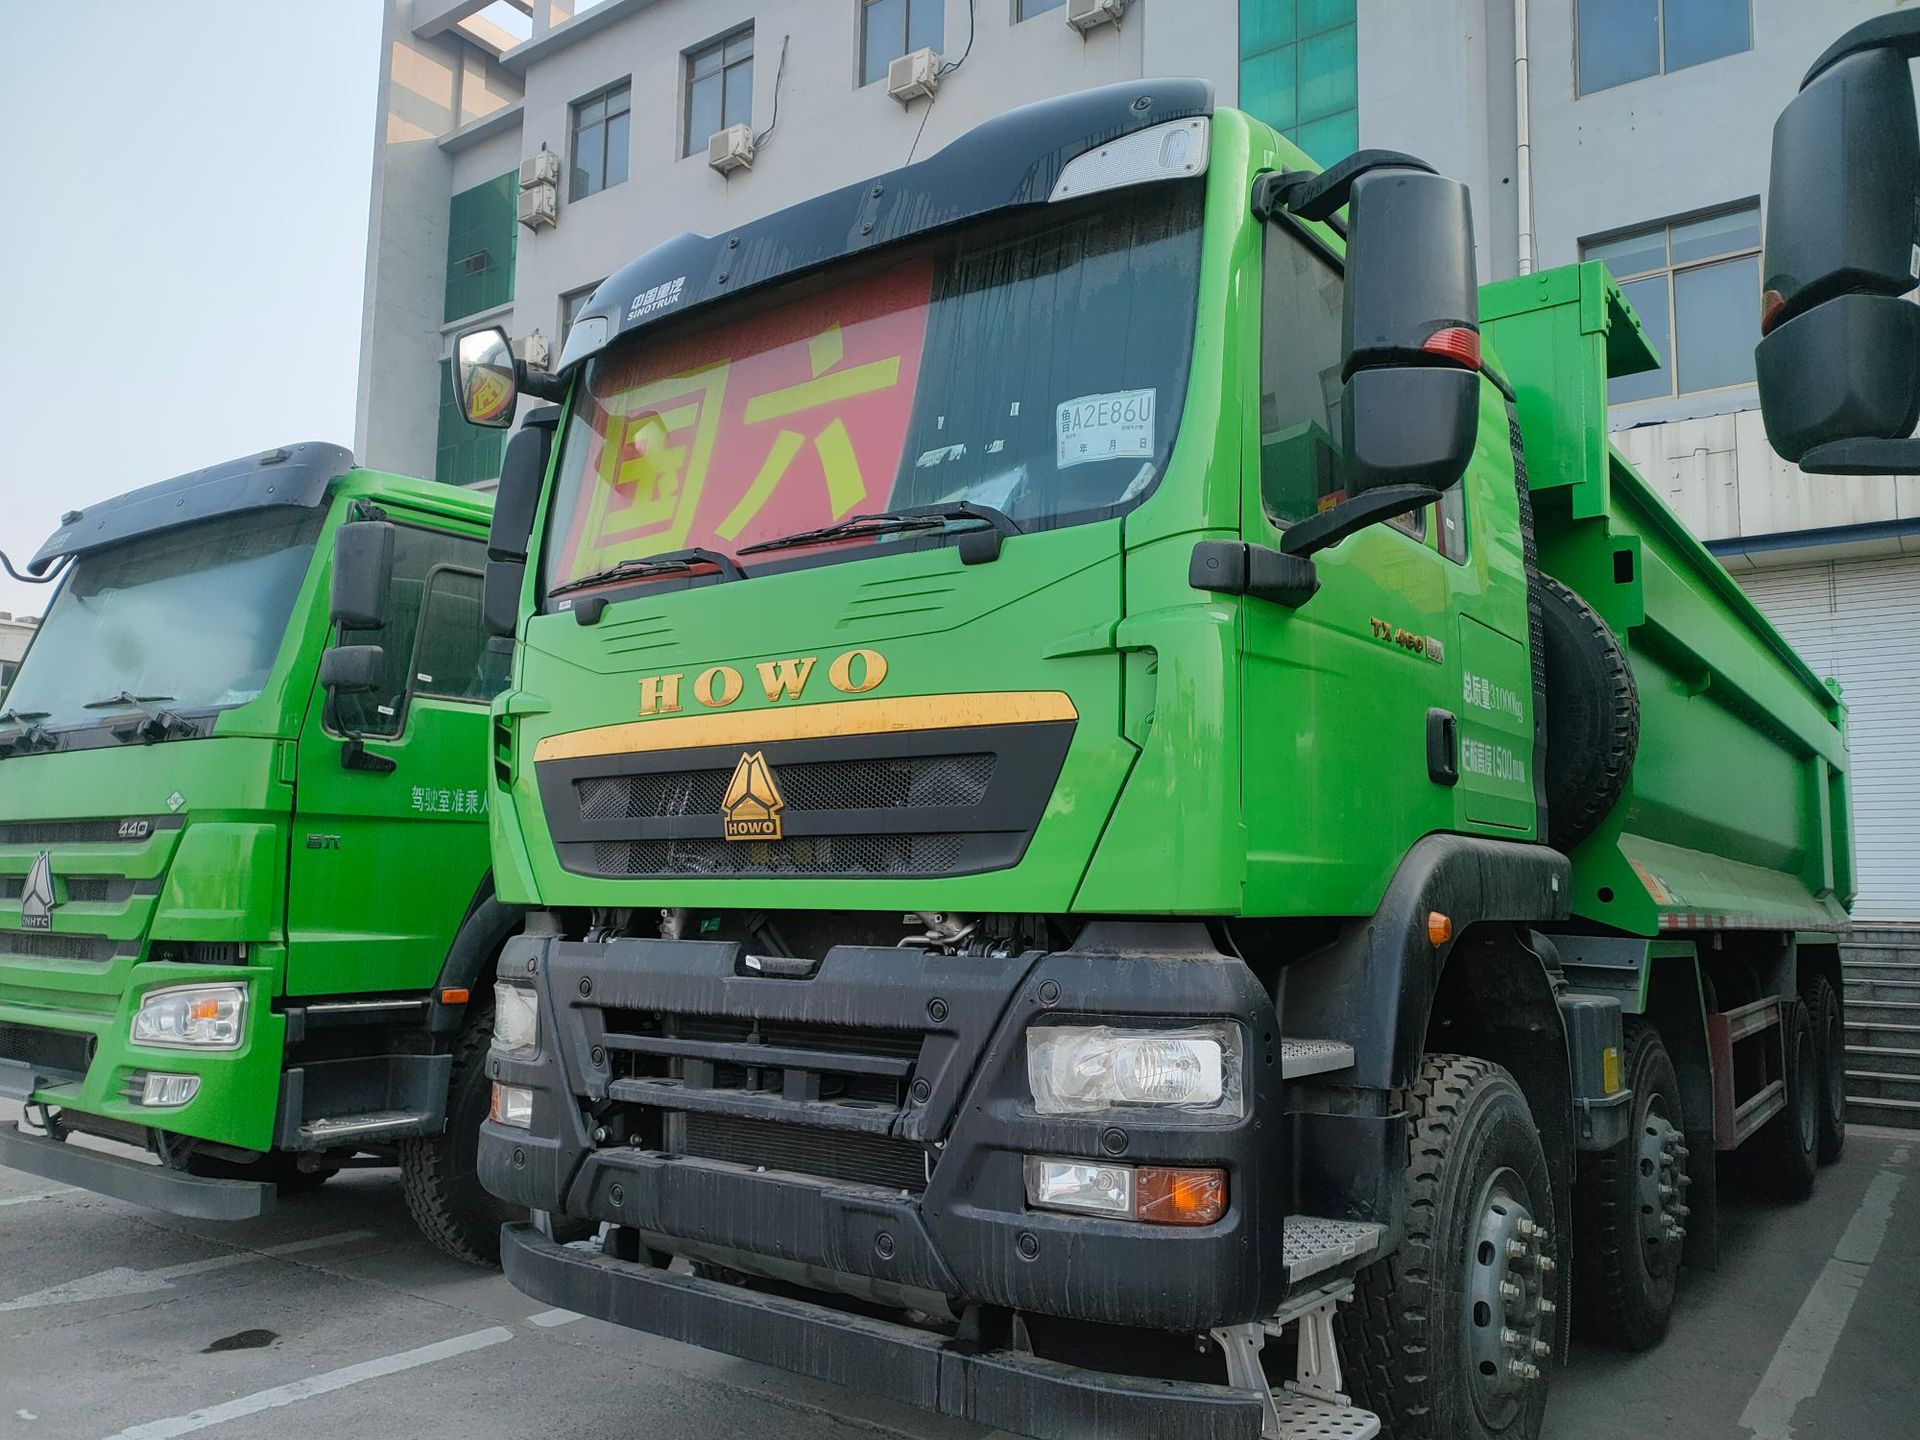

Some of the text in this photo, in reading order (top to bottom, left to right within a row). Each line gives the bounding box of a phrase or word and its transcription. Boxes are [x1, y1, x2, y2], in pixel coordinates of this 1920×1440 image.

[627, 293, 681, 321] SINOTRUK
[631, 276, 686, 310] 中国重汽
[1061, 397, 1151, 433] 鲁A2E86U
[570, 320, 901, 581] 国六
[1080, 437, 1147, 454] 年 月 日
[1370, 616, 1392, 643] TX
[637, 649, 888, 716] HOWO
[118, 821, 148, 837] 440
[728, 821, 775, 834] HOWO
